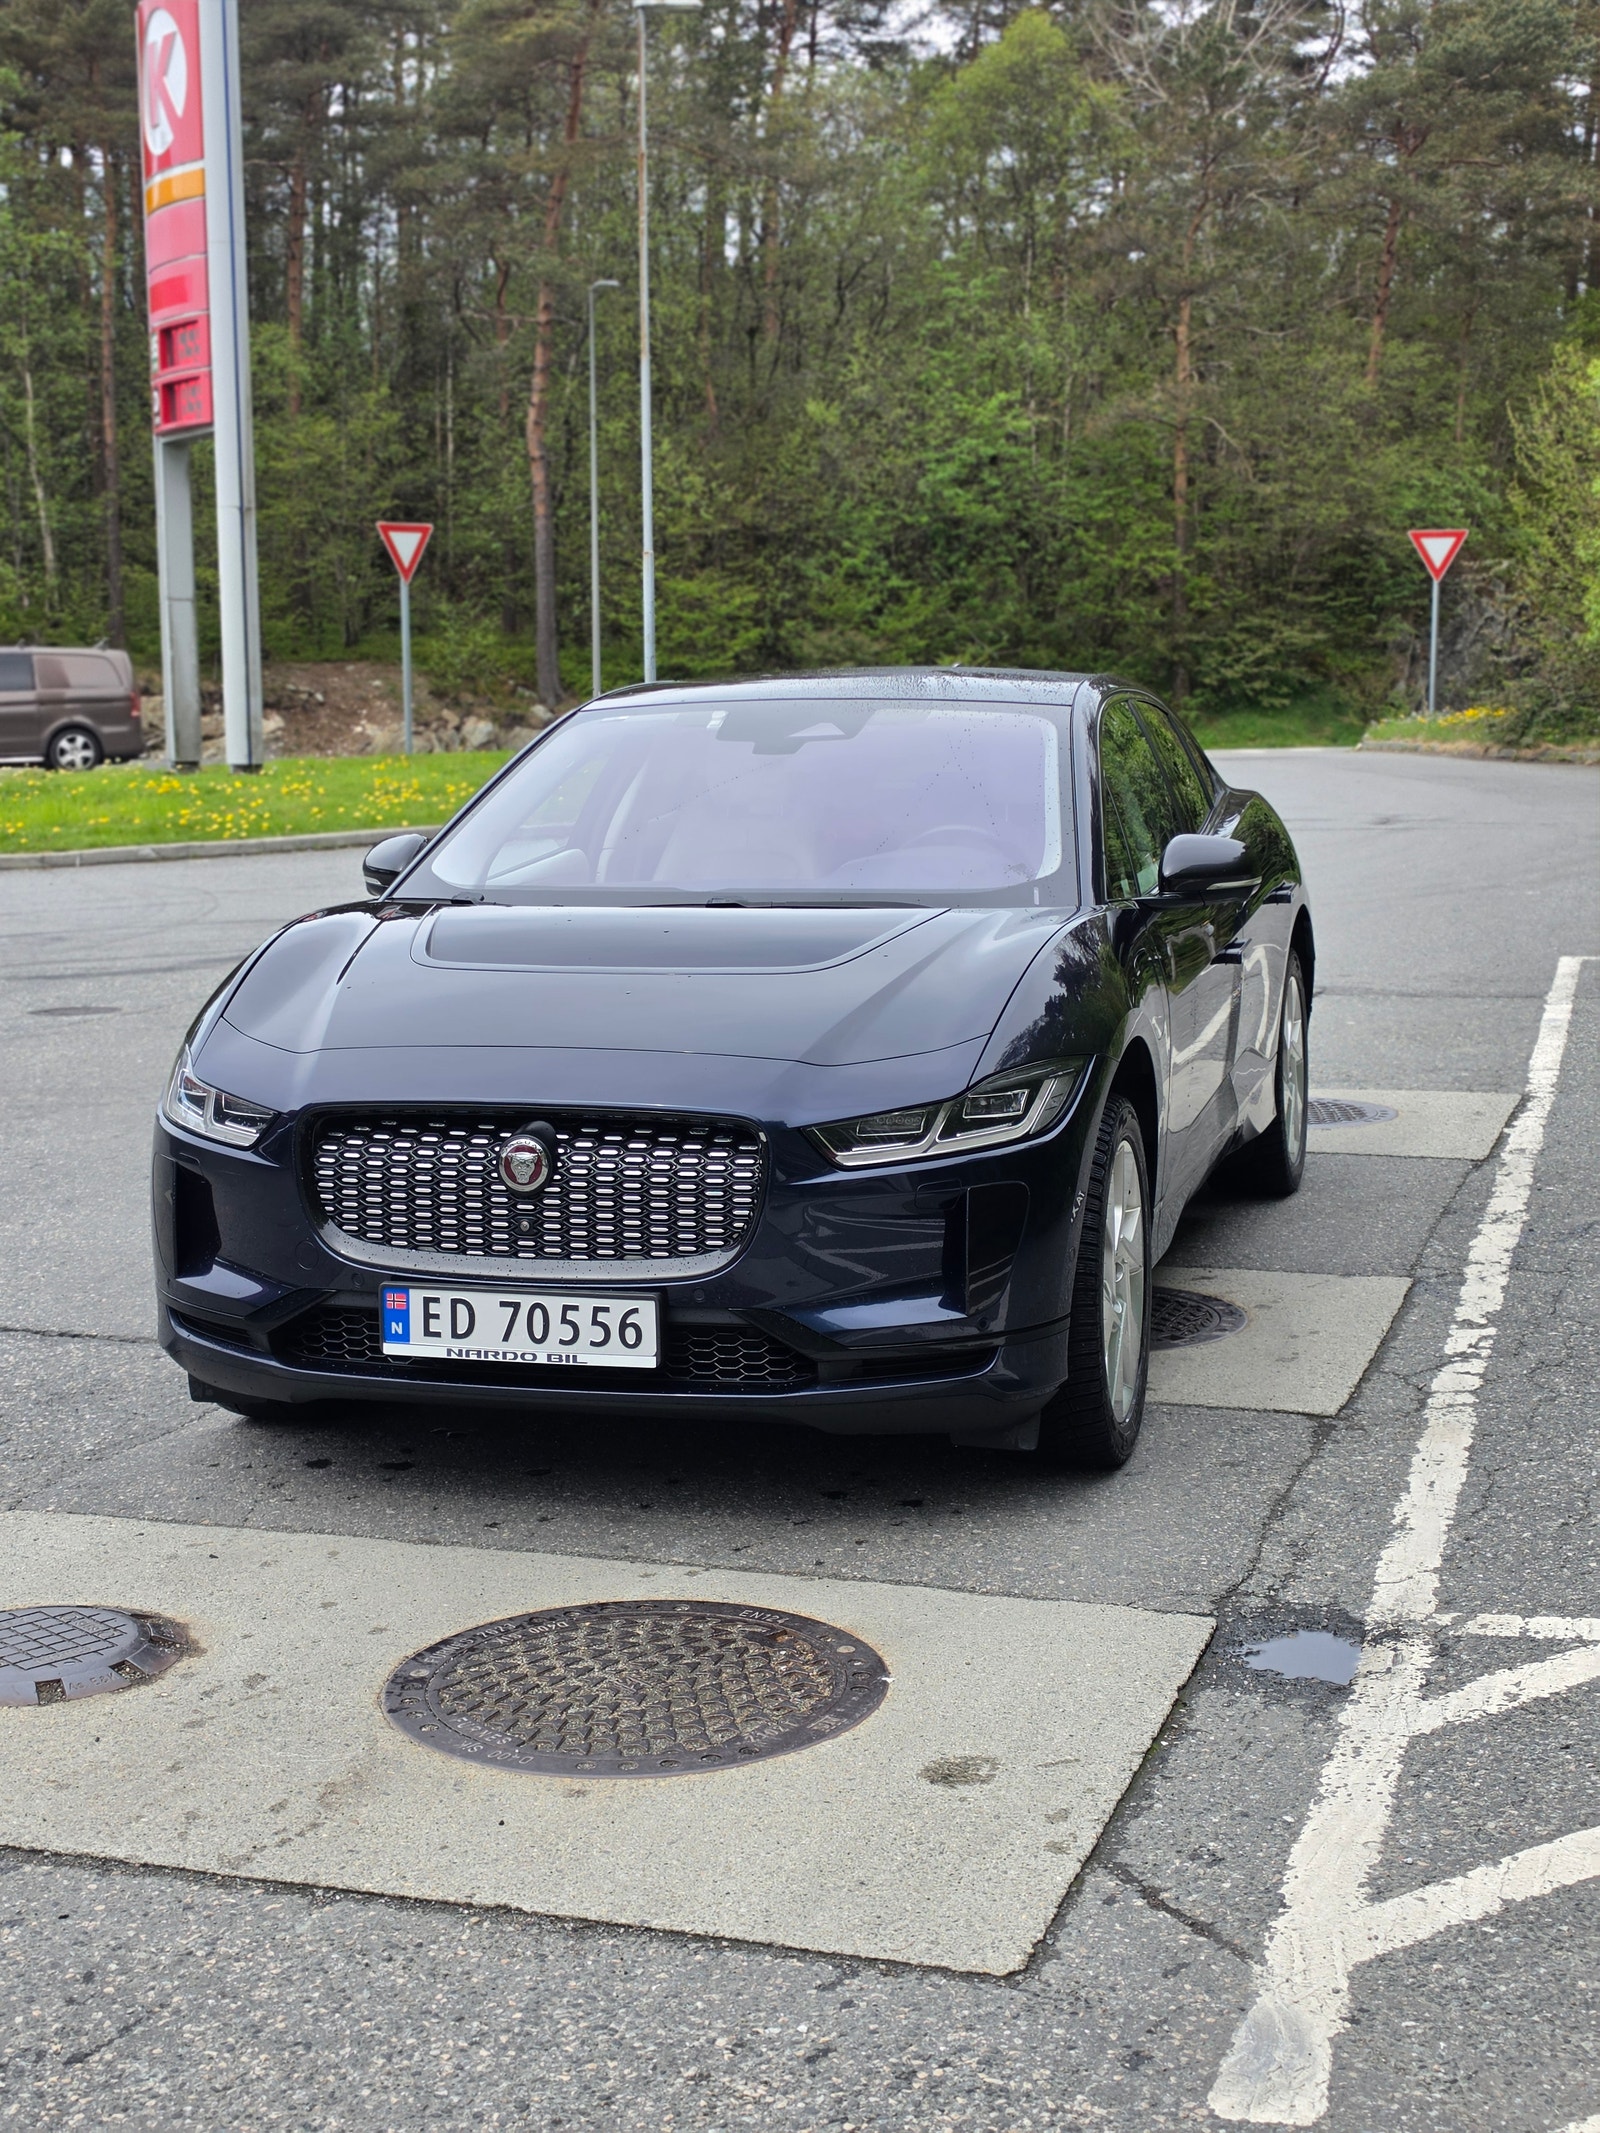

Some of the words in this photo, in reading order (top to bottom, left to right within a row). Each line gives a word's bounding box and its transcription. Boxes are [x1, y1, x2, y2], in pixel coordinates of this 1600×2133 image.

[391, 1321, 403, 1335] N
[422, 1296, 476, 1340] ED
[499, 1300, 643, 1350] 70556
[446, 1347, 538, 1363] NARDO
[546, 1353, 588, 1365] BIL
